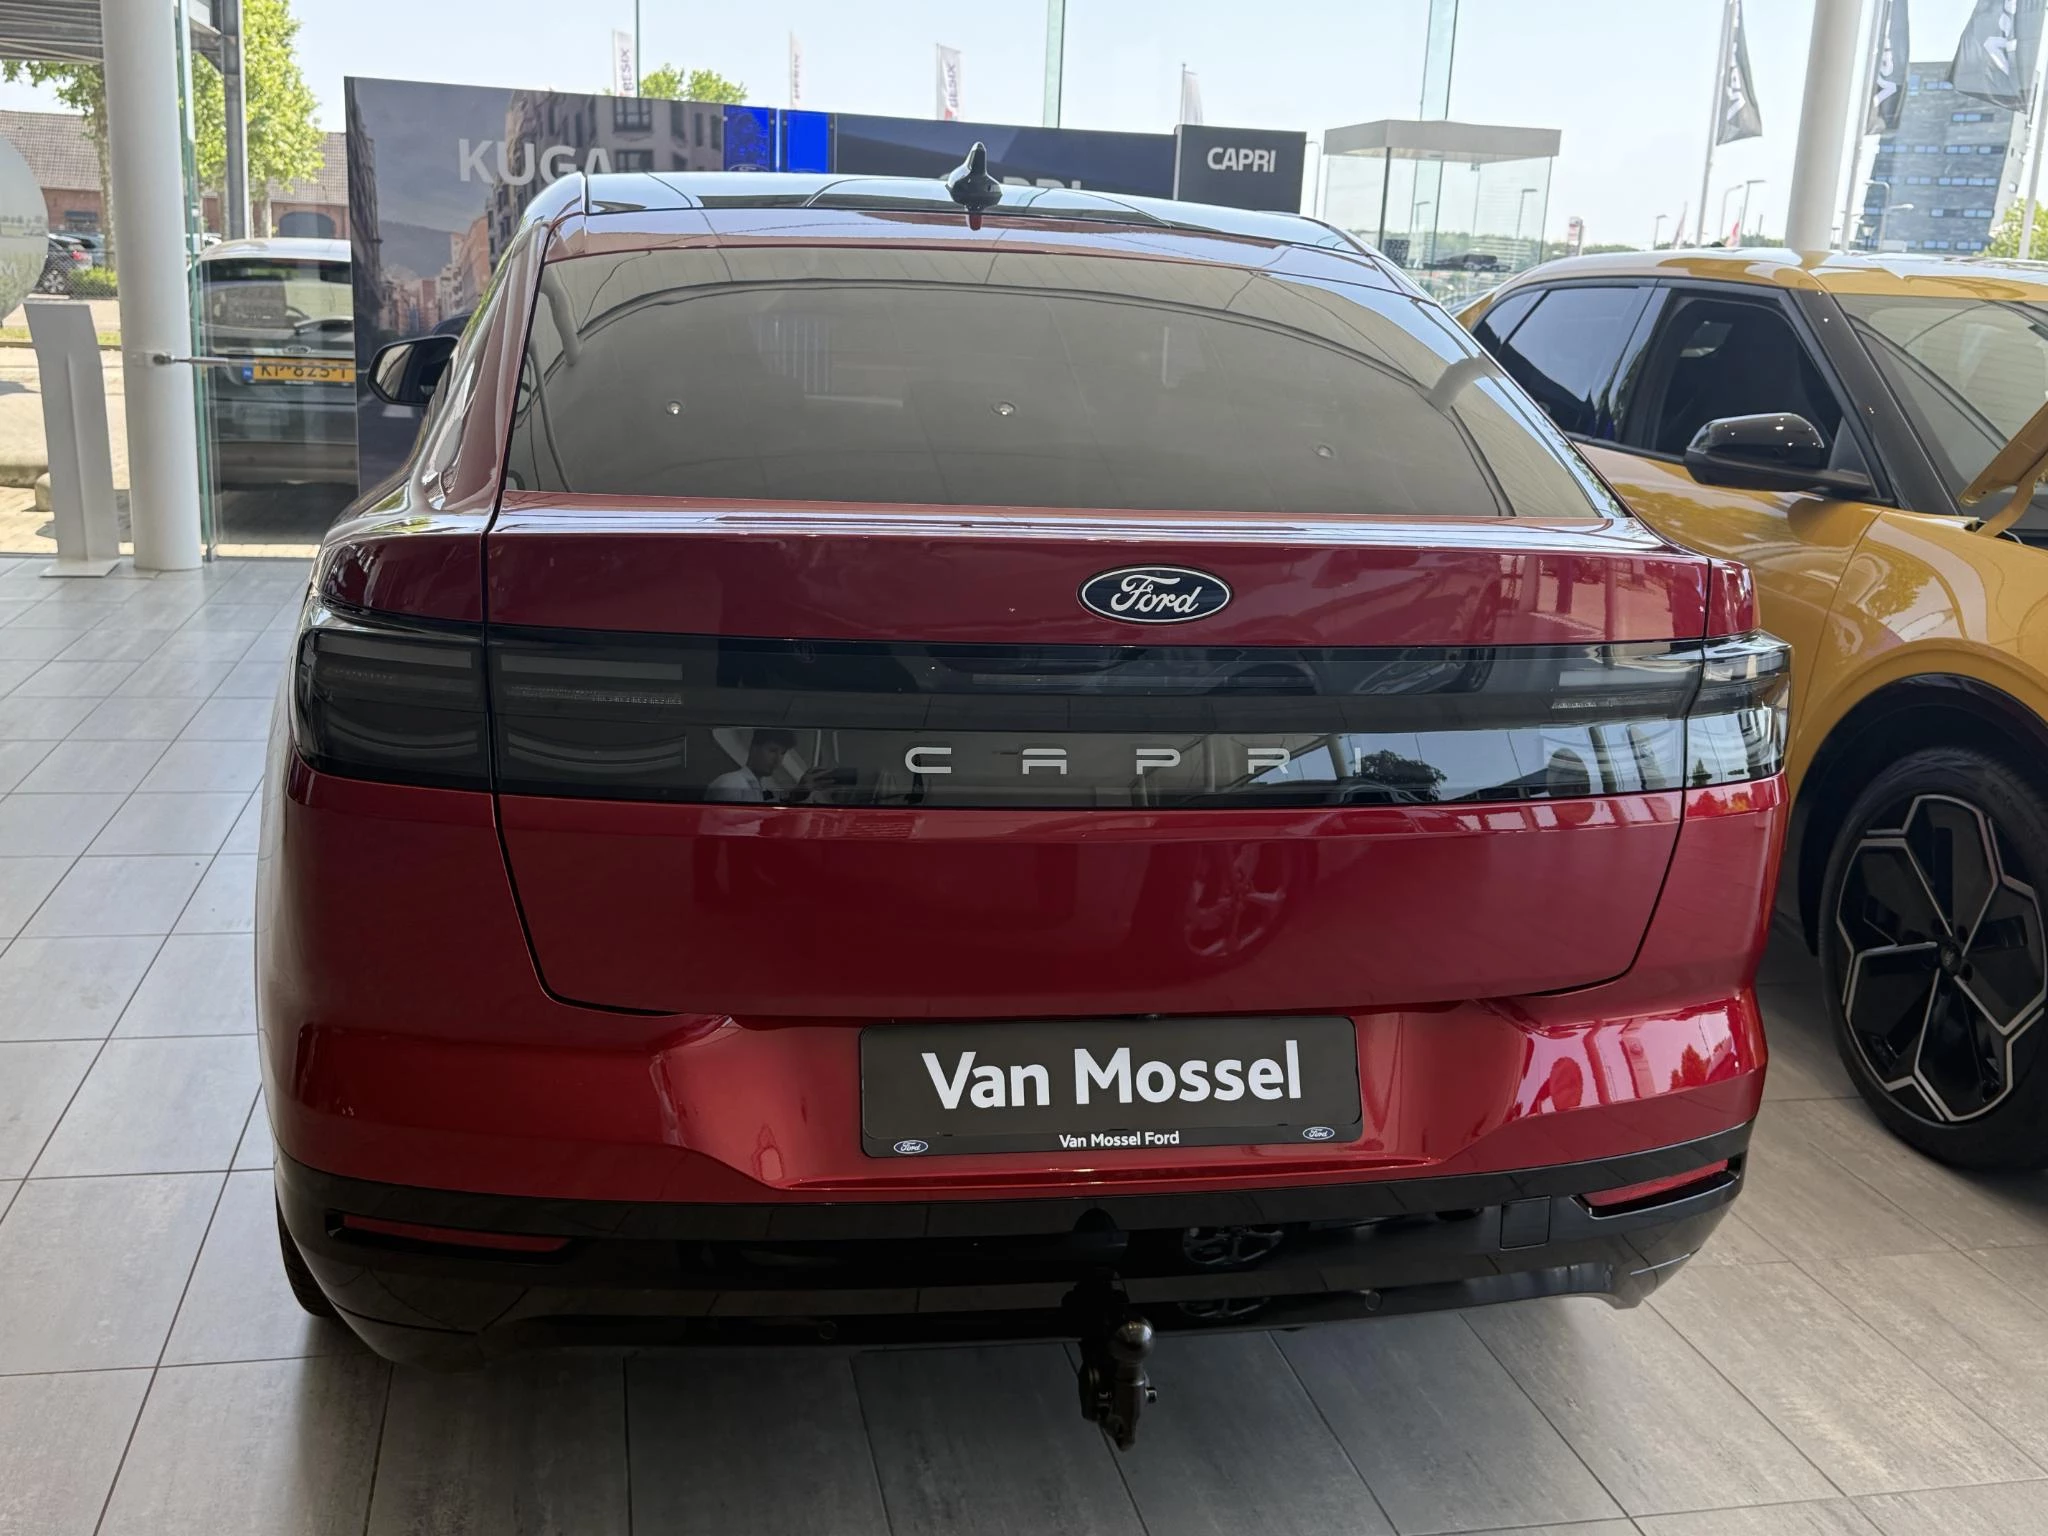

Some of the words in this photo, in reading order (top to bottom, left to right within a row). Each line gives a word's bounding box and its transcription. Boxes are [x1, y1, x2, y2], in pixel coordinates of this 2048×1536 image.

[458, 138, 612, 186] KUGA
[1207, 147, 1276, 172] CAPRI
[1110, 574, 1203, 613] Ford
[905, 746, 1362, 775] CAPRI
[921, 1051, 1050, 1109] Van
[1074, 1040, 1301, 1105] Mossel
[1059, 1134, 1087, 1148] Van
[1091, 1131, 1141, 1147] Mossel
[1144, 1130, 1180, 1145] Ford
